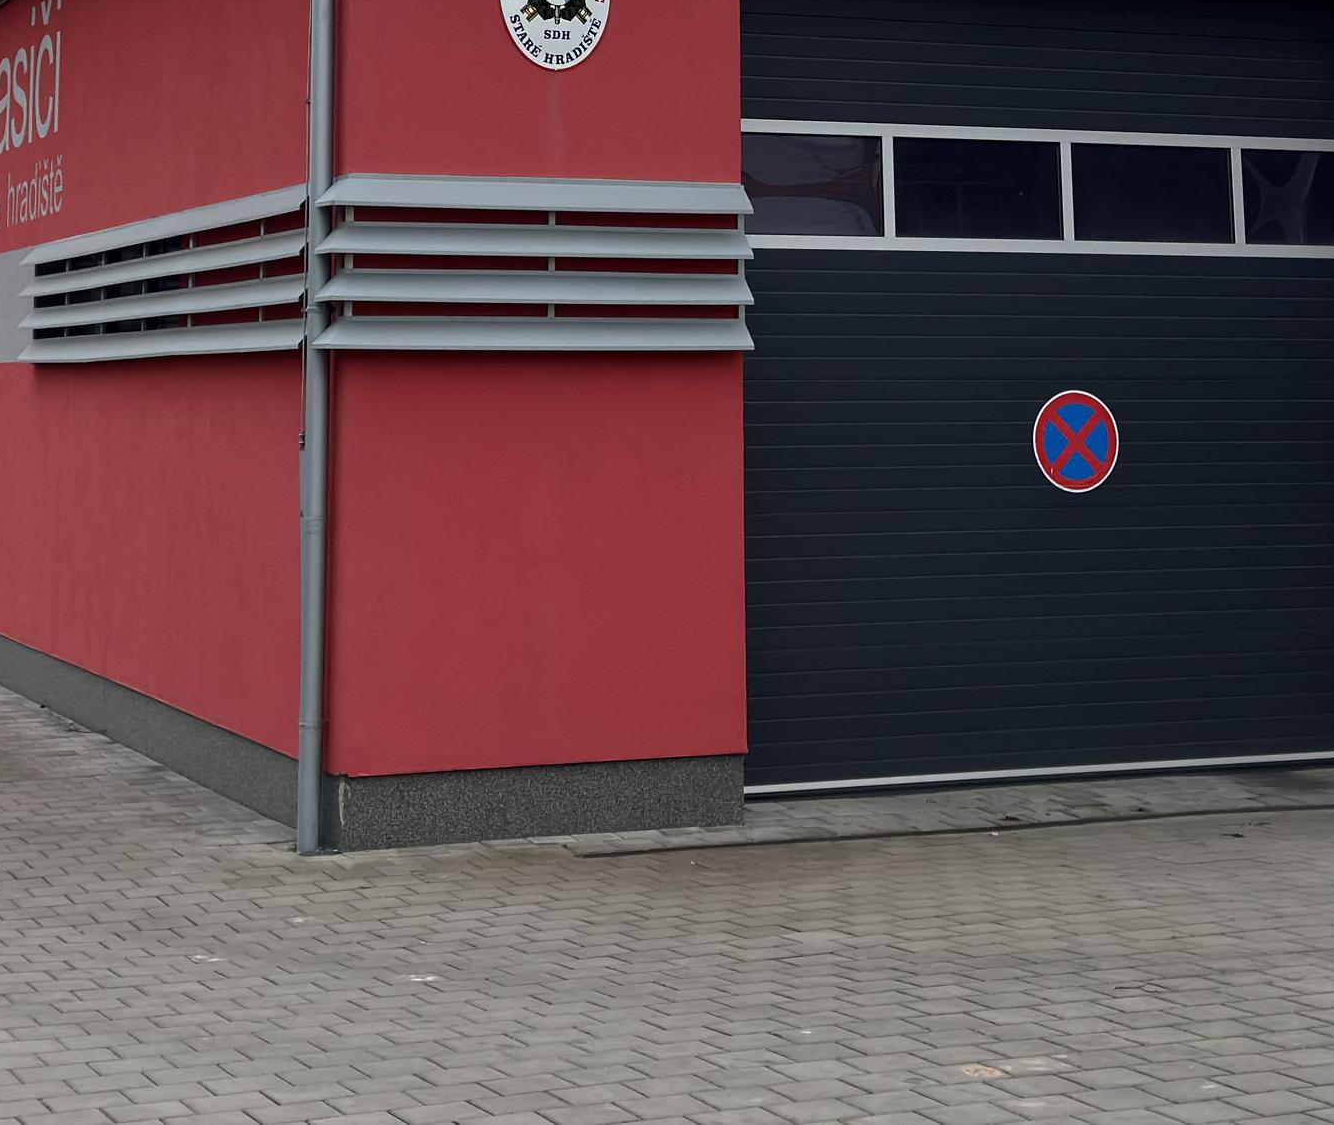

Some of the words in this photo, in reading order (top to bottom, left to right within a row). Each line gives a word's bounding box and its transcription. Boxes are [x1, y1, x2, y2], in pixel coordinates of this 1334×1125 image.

[509, 14, 543, 58] STARÉ
[543, 17, 602, 64] HRADIŠTĚ
[543, 29, 571, 40] SDH
[6, 155, 63, 227] hradiště
